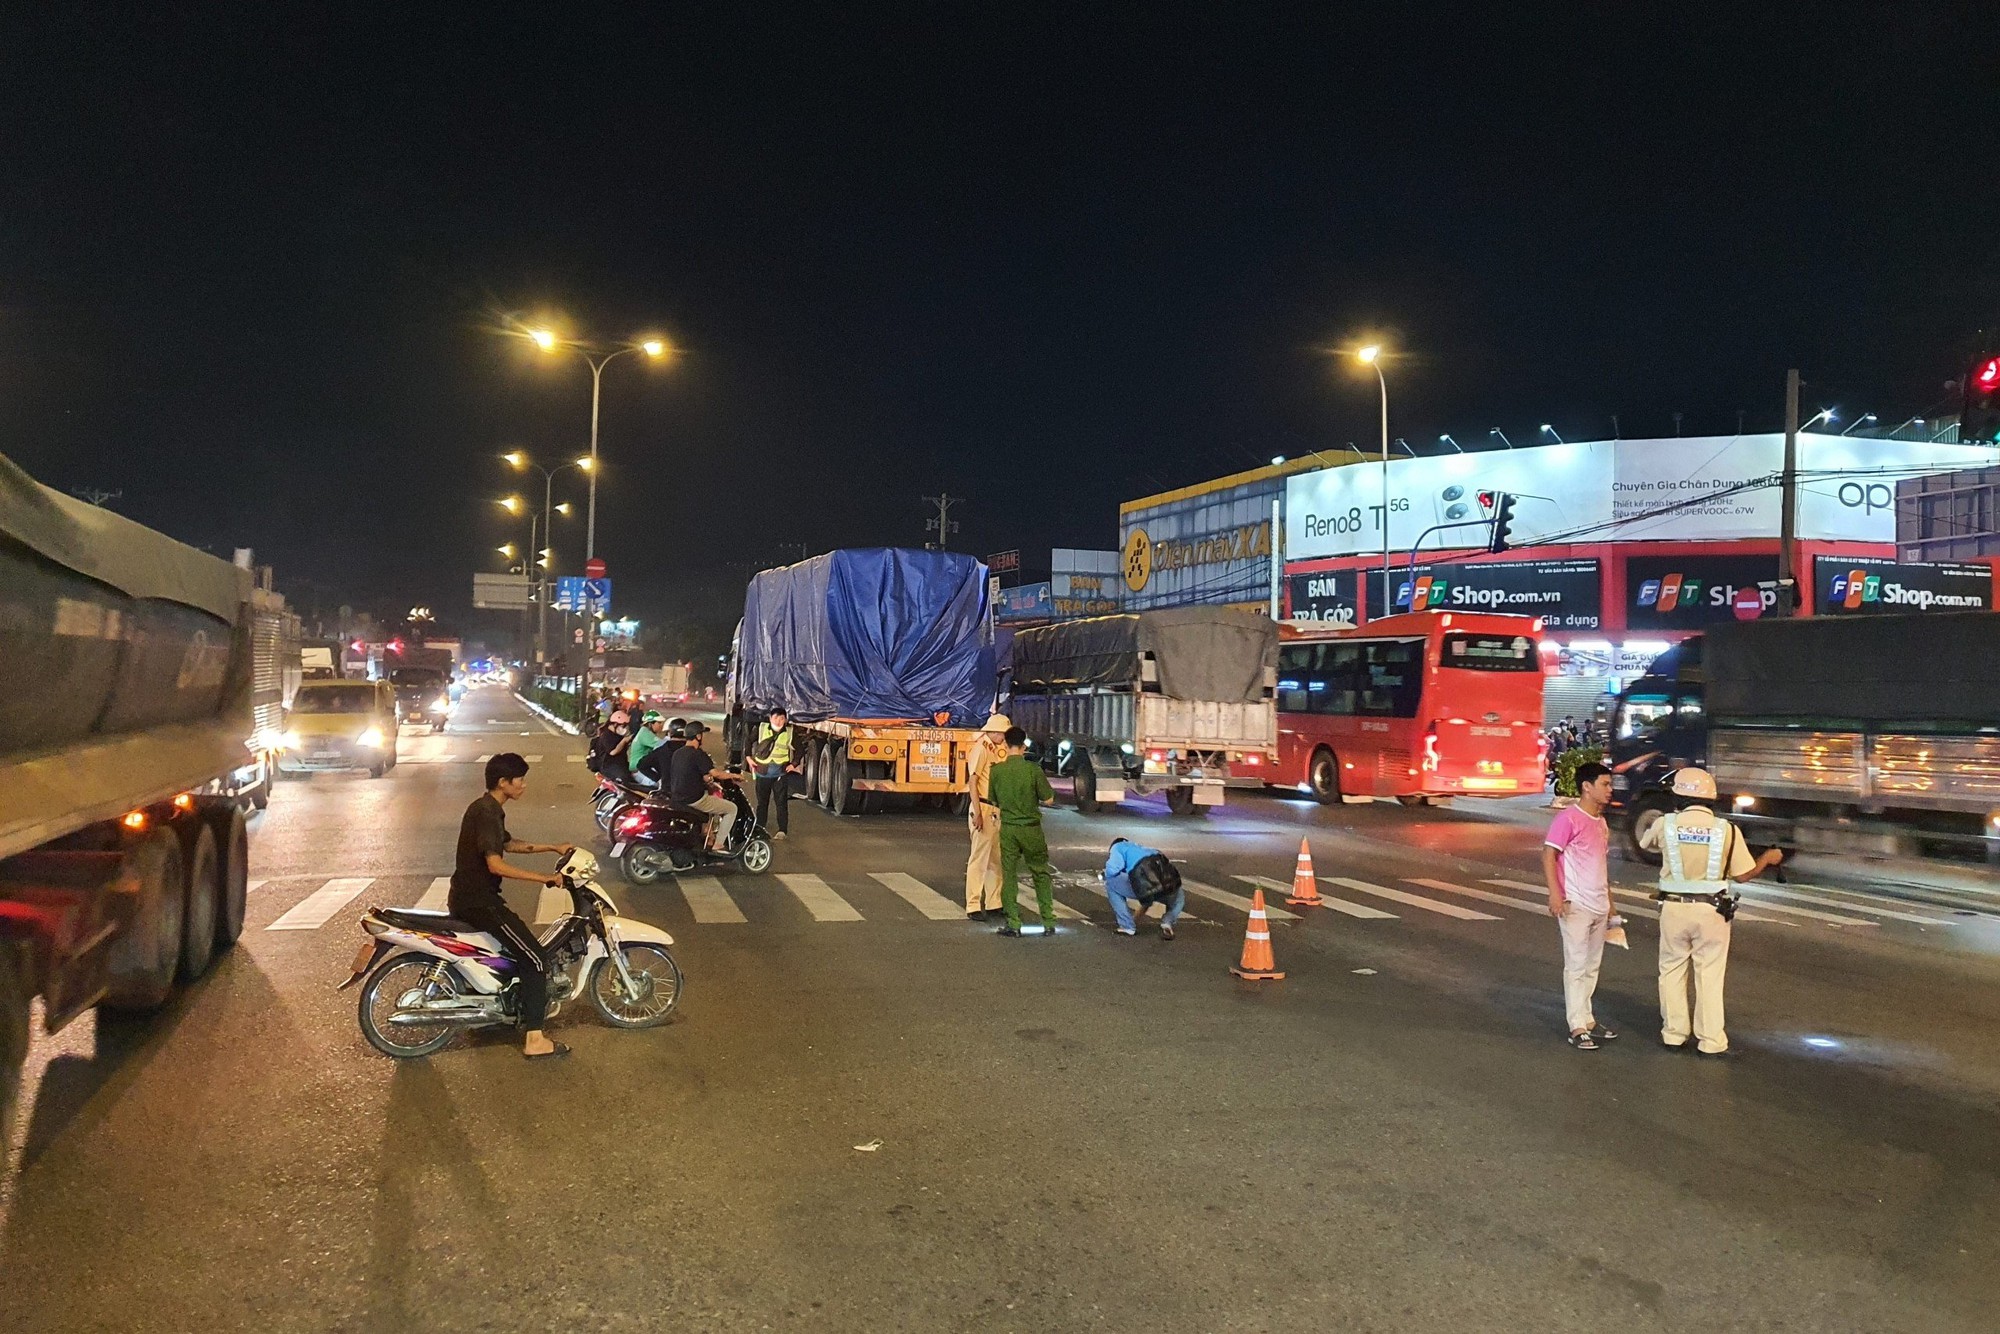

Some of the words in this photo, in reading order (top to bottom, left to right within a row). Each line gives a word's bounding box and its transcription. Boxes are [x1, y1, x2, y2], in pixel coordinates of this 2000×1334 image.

[1612, 482, 1654, 492] Chuyên
[1657, 481, 1677, 490] Gia
[1679, 480, 1710, 489] Chân
[1390, 498, 1409, 512] 5G
[1838, 482, 1892, 516] op
[1305, 507, 1362, 538] Reno8
[1368, 505, 1386, 530] T
[1236, 521, 1271, 559] XA
[1308, 574, 1336, 598] BÁN
[1452, 586, 1561, 608] Shop.com.vn
[1709, 585, 1777, 611] Shp
[1883, 583, 1983, 610] Shop.com.vn
[1566, 614, 1598, 627] dụng
